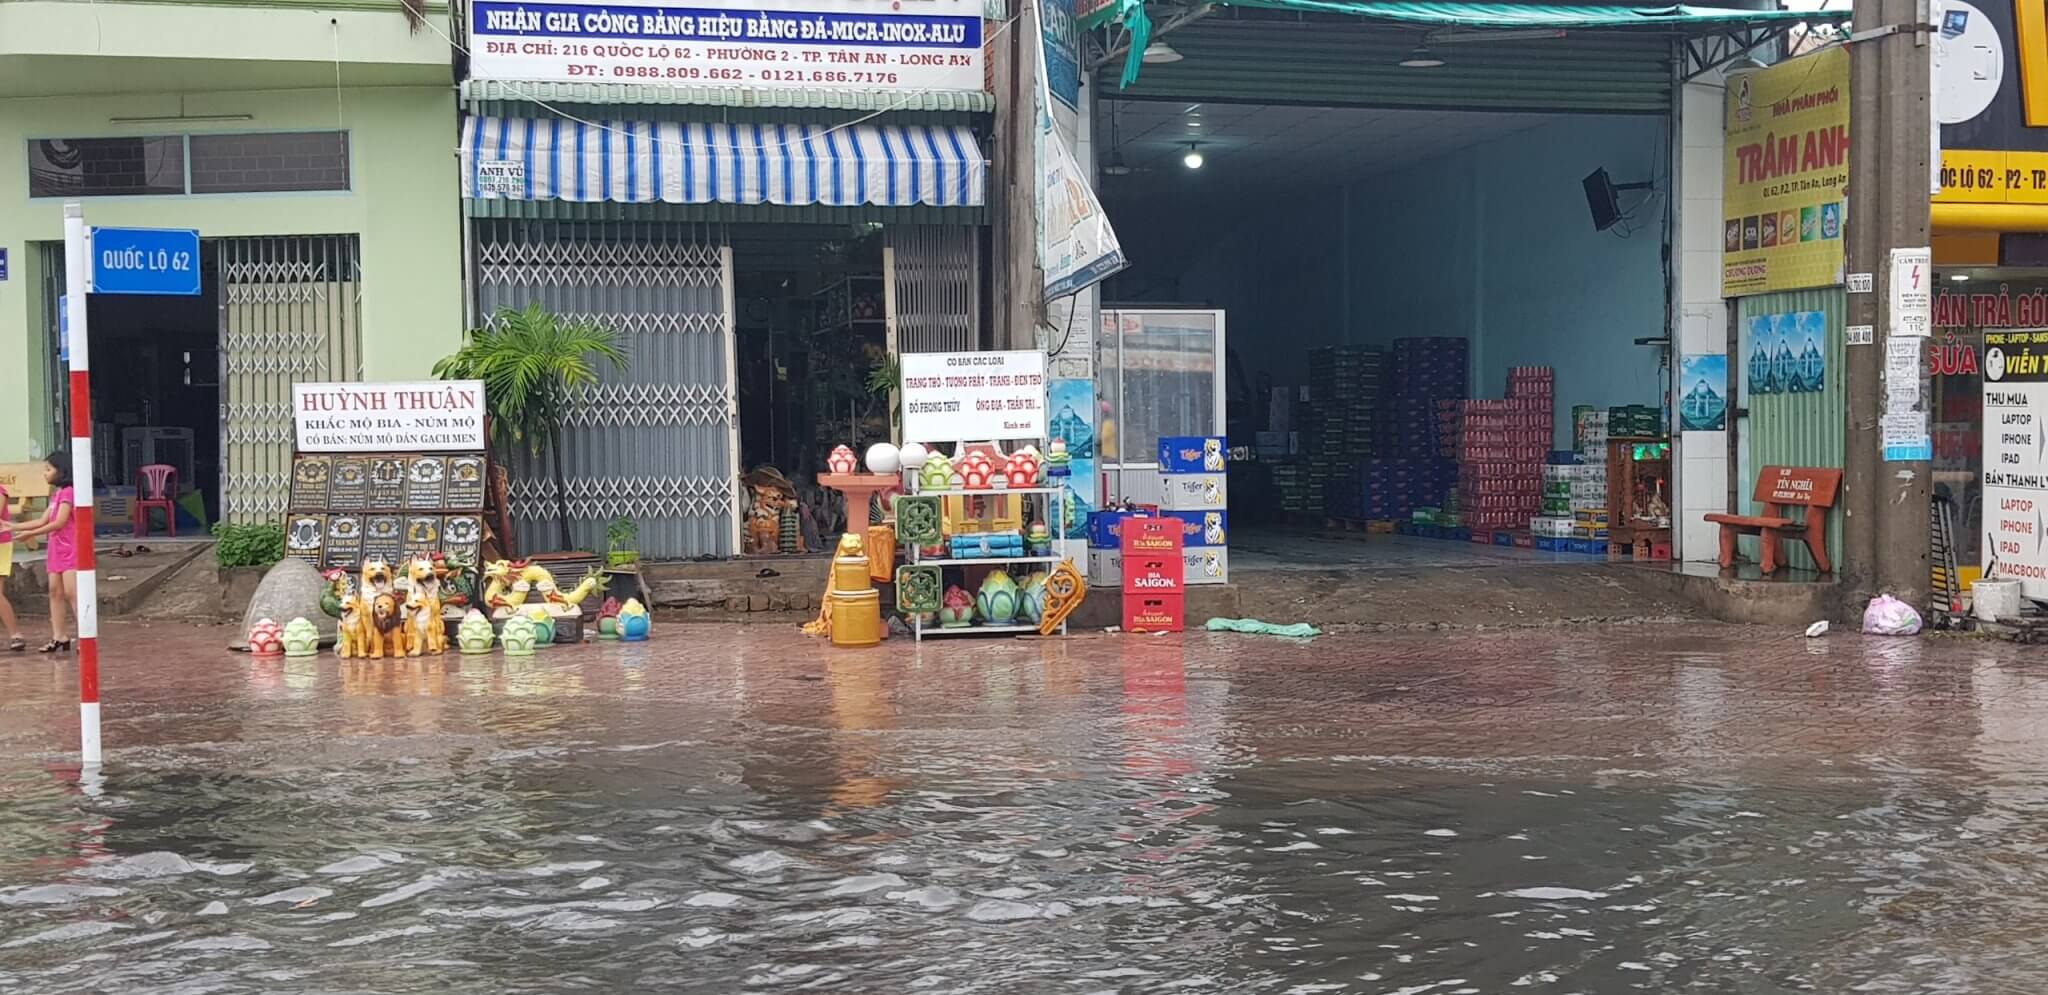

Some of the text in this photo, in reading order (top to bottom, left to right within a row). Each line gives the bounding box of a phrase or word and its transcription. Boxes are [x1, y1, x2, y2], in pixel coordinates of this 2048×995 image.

[486, 9, 541, 35] NHẬN
[546, 13, 581, 32] GIA
[584, 9, 637, 34] CÔNG
[643, 9, 695, 36] BẢNG
[698, 12, 742, 41] HIỆU
[747, 11, 798, 40] BẰNG
[486, 41, 517, 56] ĐỊA
[522, 38, 557, 56] CHỈ:
[563, 45, 588, 56] 216
[593, 41, 643, 58] QUỐC
[648, 45, 670, 61] LỘ
[675, 48, 691, 59] 62
[707, 47, 776, 61] PHƯỜNG
[783, 51, 789, 62] 2
[802, 51, 822, 63] TP.
[828, 51, 859, 64] TÂN
[864, 53, 887, 64] AN
[900, 54, 944, 65] LONG
[949, 55, 971, 66] AN
[567, 64, 604, 77] ĐT:
[613, 66, 742, 80] 0988.809.662
[762, 70, 897, 83] 0121.686.7176
[1773, 97, 1790, 117] NHÀ
[1792, 93, 1816, 112] PHÂN
[1817, 84, 1839, 106] PHỐI
[1736, 131, 1798, 184] TRÂM
[480, 167, 504, 176] ANH
[1960, 165, 1973, 192] LỘ
[1978, 169, 1993, 188] 62
[2006, 170, 2021, 189] P2
[1822, 176, 1837, 188] Long
[103, 245, 190, 273] QUỐC LỘ 62
[1971, 283, 2012, 328] TRẢ
[1929, 331, 1978, 375] SỬA
[2005, 347, 2039, 374] VIỄN
[302, 386, 475, 412] HUỲNH THUẬN
[1986, 392, 2028, 405] THU MUA
[305, 415, 345, 430] KHẮC
[350, 417, 372, 431] MỘ
[377, 416, 401, 428] BIA
[415, 415, 448, 428] NÚM
[452, 416, 475, 430] MỘ
[2002, 414, 2031, 425] LAPTOP
[305, 433, 321, 445] CÓ
[349, 432, 373, 444] NÚM
[376, 433, 393, 445] MỘ
[395, 432, 418, 444] DÁN
[421, 433, 450, 445] GẠCH
[452, 433, 476, 443] MEN
[2001, 433, 2031, 445] IPHONE
[1180, 449, 1202, 461] Tiger
[2001, 453, 2020, 464] IPAD
[1777, 477, 1790, 489] TÍN
[1985, 469, 2003, 485] BÁN
[2006, 473, 2037, 487] THANH
[1182, 481, 1202, 493] Tiger
[2001, 498, 2032, 512] LAPTOP
[2000, 520, 2032, 534] IPHONE
[2000, 541, 2020, 554] IPAD
[2000, 562, 2046, 579] MACBOOK
